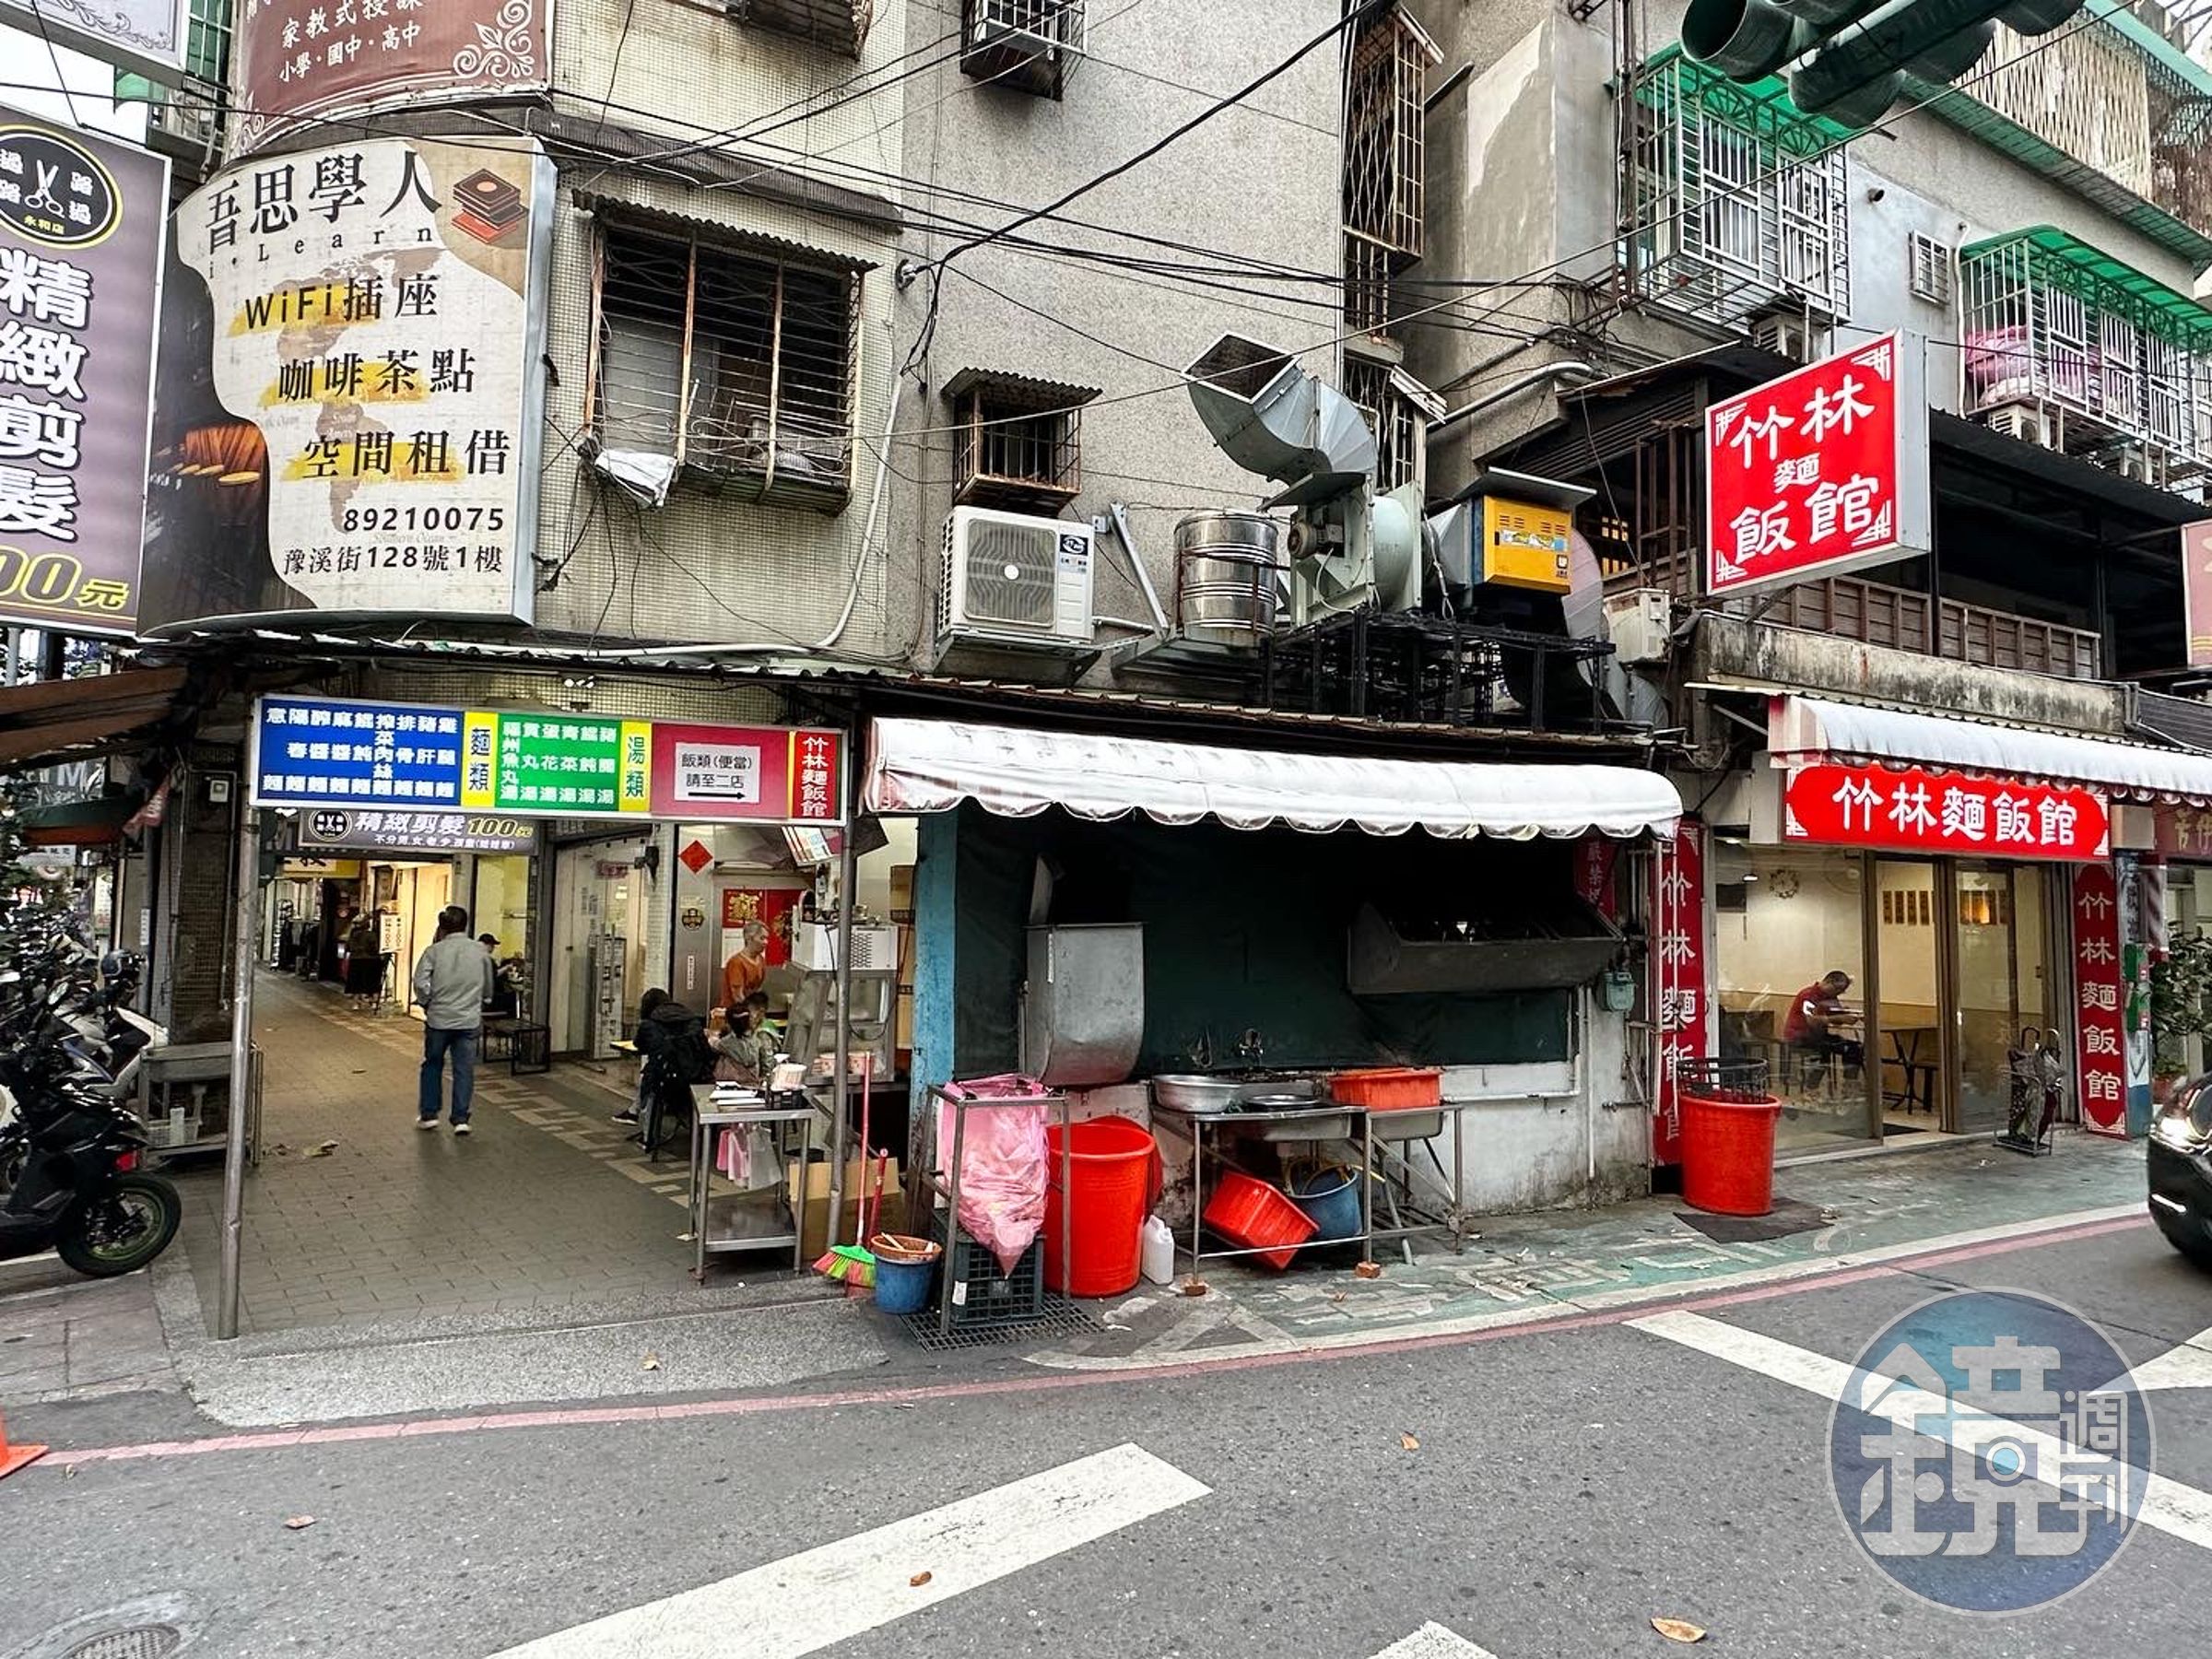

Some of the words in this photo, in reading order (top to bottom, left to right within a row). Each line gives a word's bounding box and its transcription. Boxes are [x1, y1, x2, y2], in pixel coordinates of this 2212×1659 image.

[205, 150, 442, 254] 吾思學人
[278, 348, 475, 402] 咖啡茶點
[1729, 373, 1875, 469] 竹林
[302, 429, 511, 478] 空間租借
[1773, 453, 1820, 493] 麵
[343, 507, 504, 532] 89210075
[1729, 474, 1879, 565] 飯館
[284, 545, 503, 575] 豫溪街128號1樓
[394, 714, 417, 797] 排骨麵
[469, 727, 491, 791] 麵類
[625, 736, 646, 797] 湯類
[686, 773, 745, 789] 請至二店
[801, 736, 829, 817] 竹林麵飯館
[354, 810, 466, 835] 精緻剪髮
[1832, 776, 2077, 847] 竹林麵飯館
[2077, 891, 2121, 1100] 竹林麵飯館
